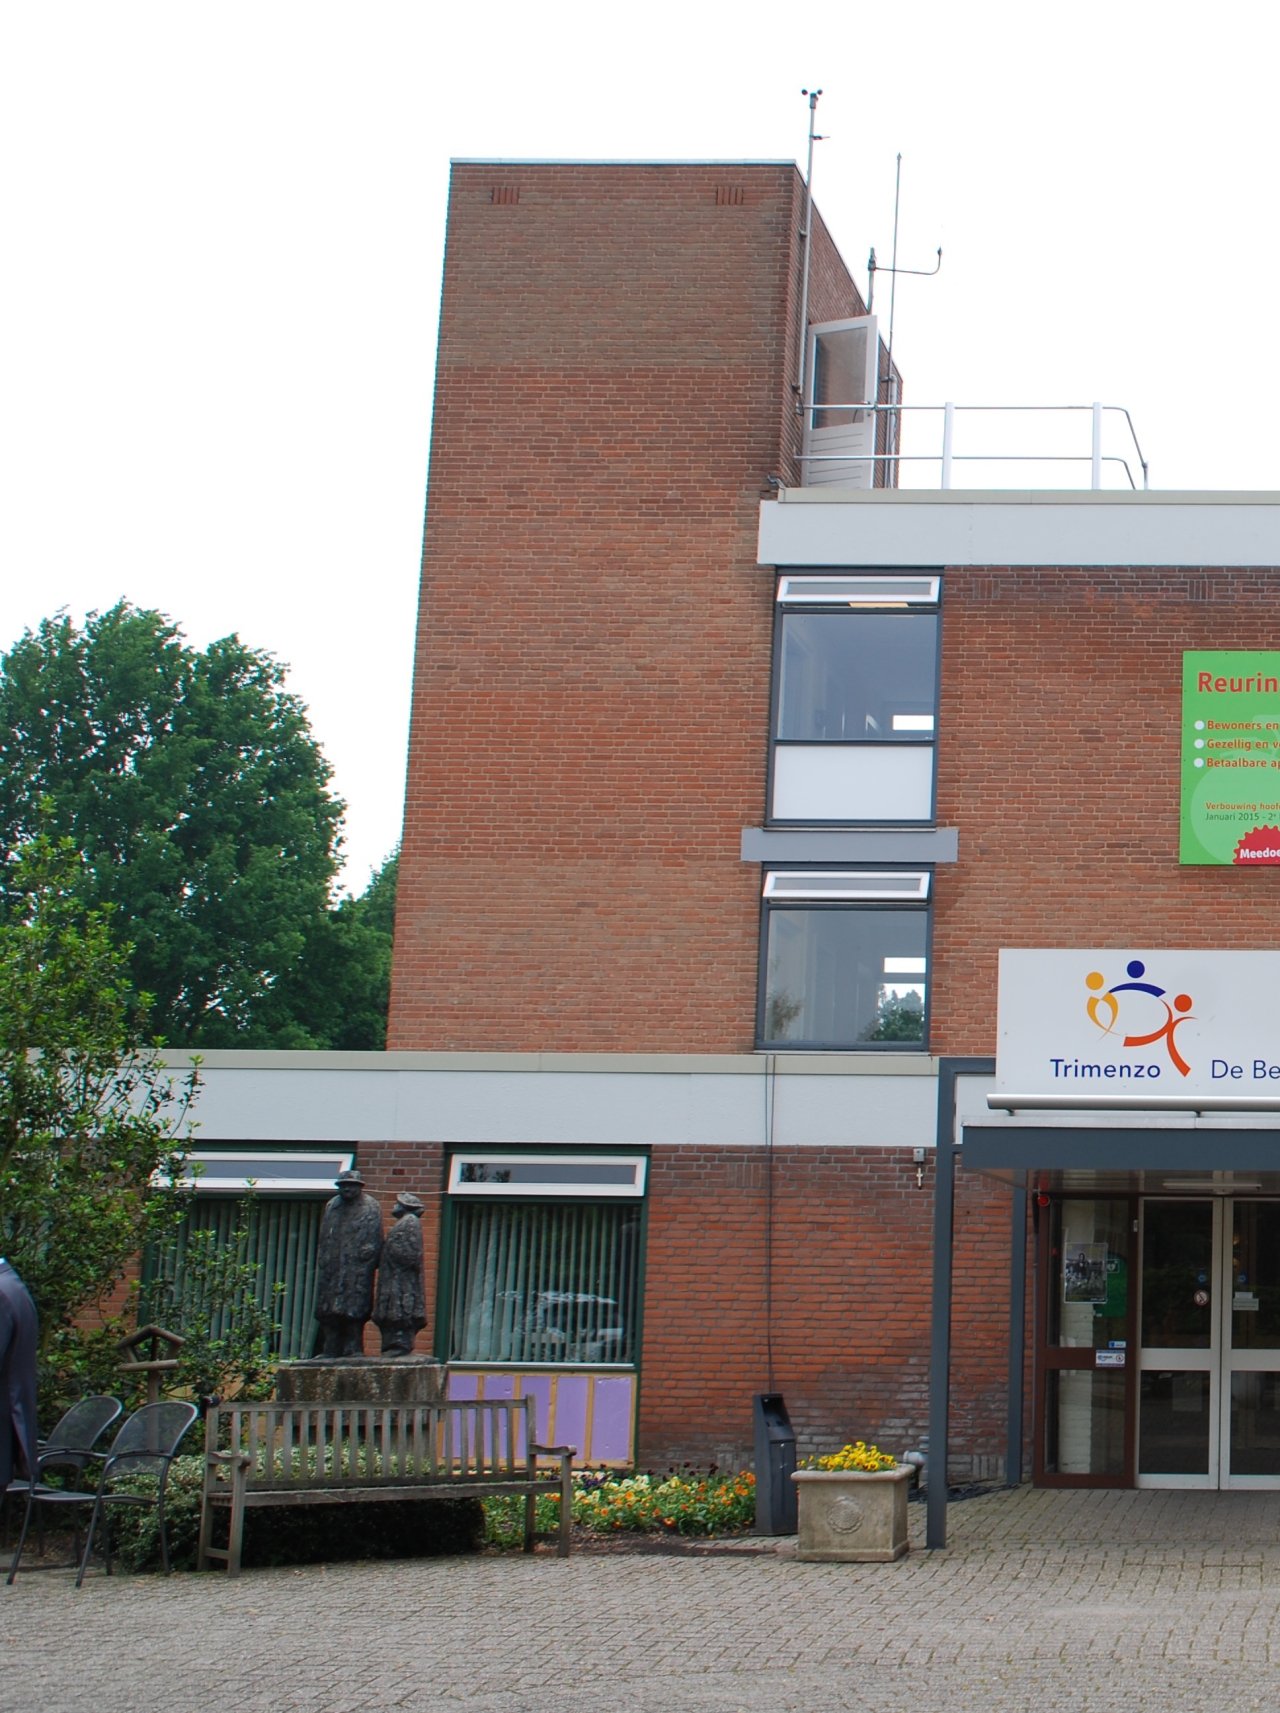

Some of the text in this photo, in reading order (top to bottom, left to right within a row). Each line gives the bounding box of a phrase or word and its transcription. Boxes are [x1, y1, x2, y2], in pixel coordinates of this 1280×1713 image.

[1207, 720, 1262, 730] Bewoners
[1265, 722, 1279, 730] en
[1207, 739, 1251, 751] Gezellig
[1255, 740, 1269, 749] en
[1206, 757, 1267, 768] Betaalbare
[1206, 802, 1257, 812] Verbouwing
[1205, 812, 1236, 821] Januari
[1238, 812, 1260, 821] 2015
[1050, 1058, 1161, 1079] Trimenzo
[1211, 1059, 1243, 1080] De
